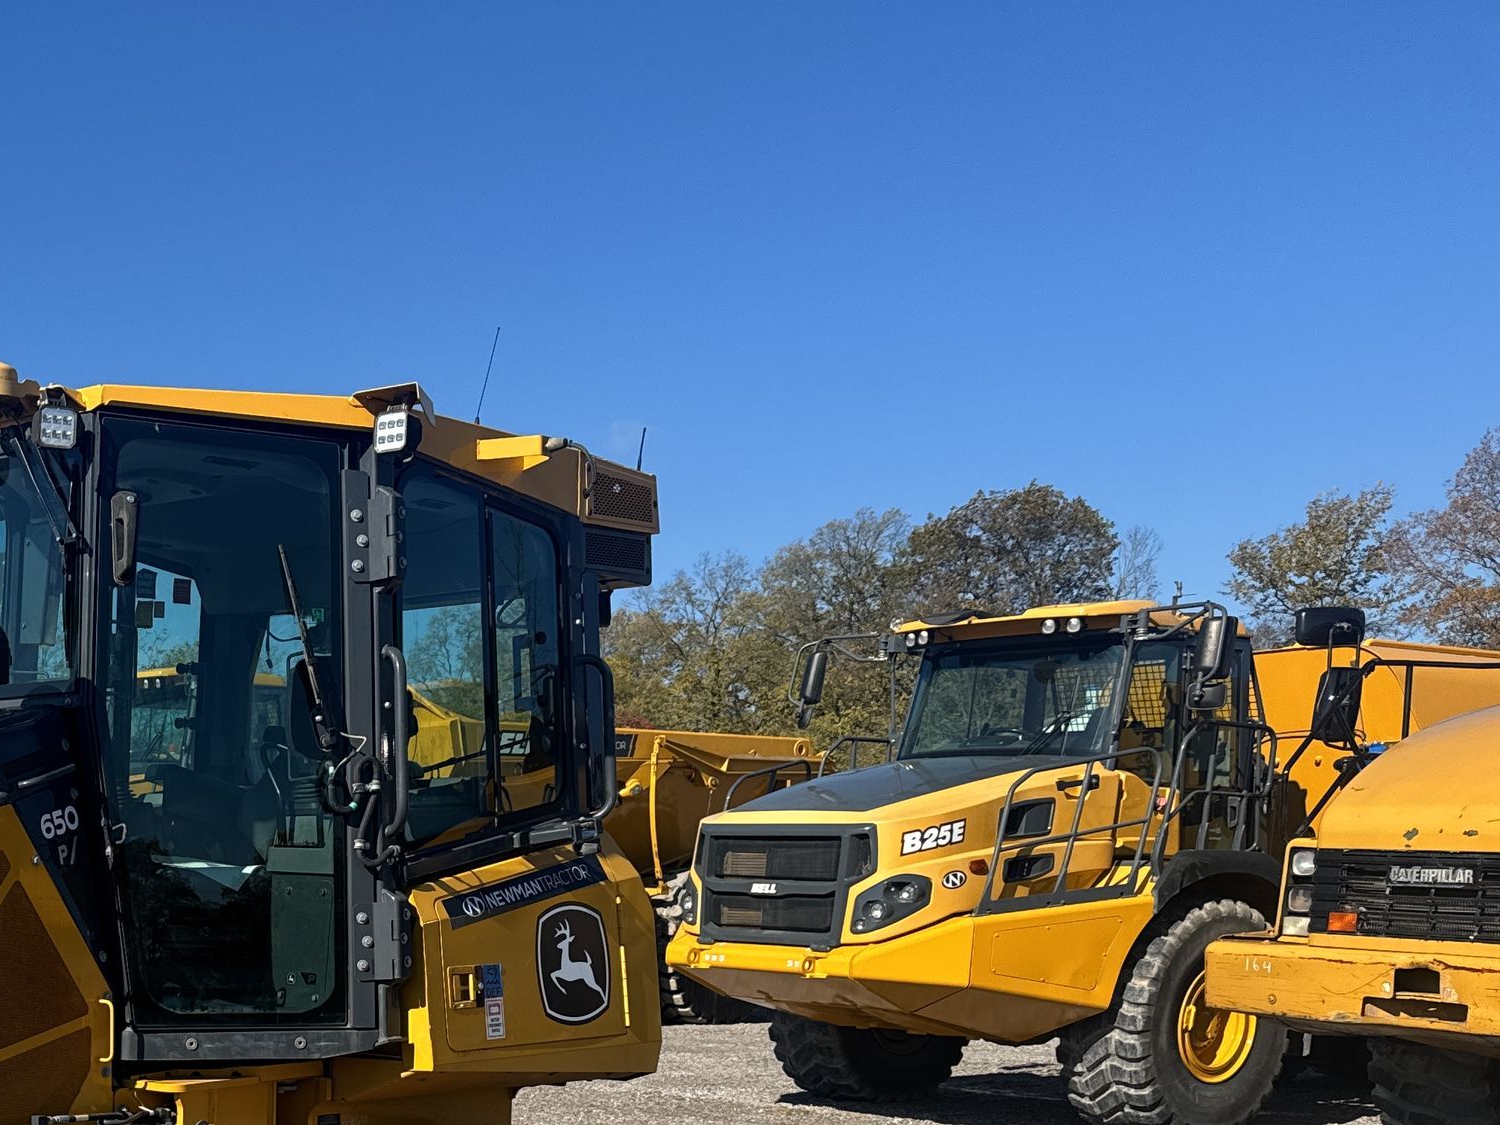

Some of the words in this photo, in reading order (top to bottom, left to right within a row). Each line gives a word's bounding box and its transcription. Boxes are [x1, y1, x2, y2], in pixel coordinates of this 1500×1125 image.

[40, 805, 79, 839] 650
[901, 819, 966, 855] B25E
[1389, 865, 1473, 884] CATERPILLAR
[750, 883, 777, 894] BELL
[1244, 957, 1272, 973] 164
[486, 986, 501, 997] DEF
